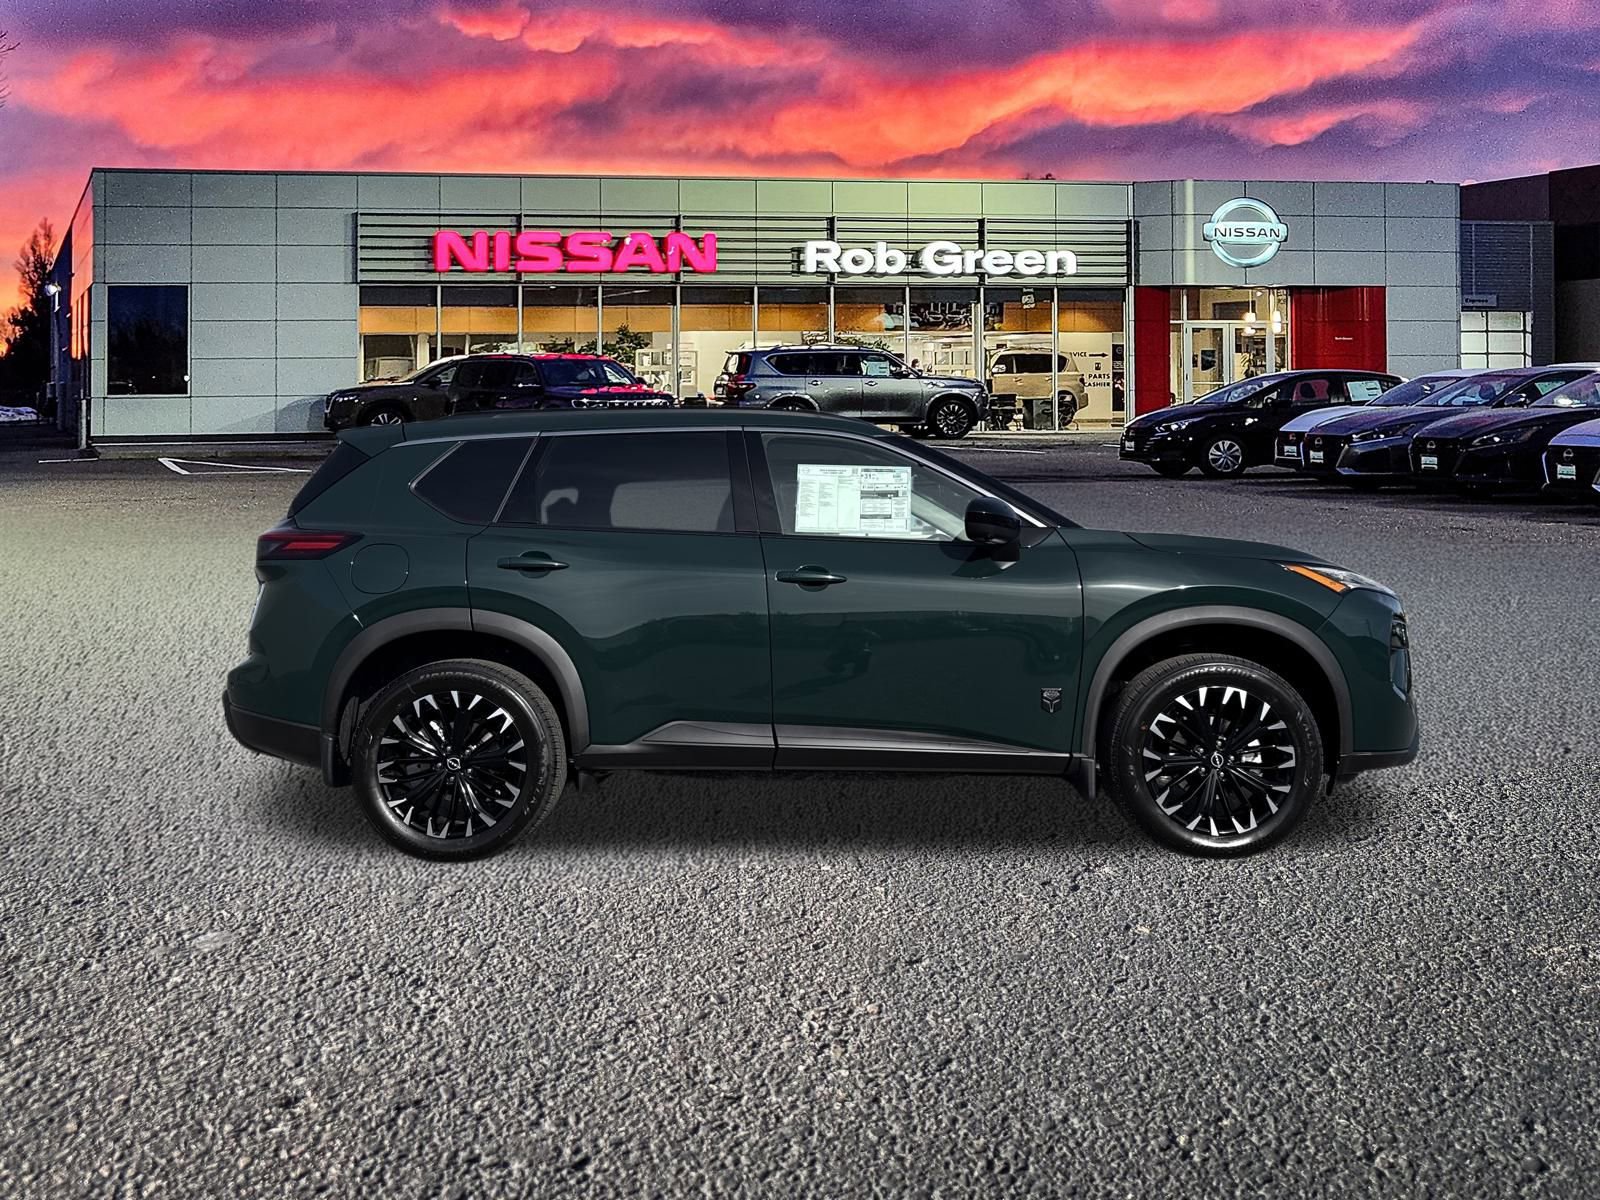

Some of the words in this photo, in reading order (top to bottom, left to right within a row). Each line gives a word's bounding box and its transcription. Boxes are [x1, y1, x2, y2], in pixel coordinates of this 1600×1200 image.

[1214, 227, 1280, 238] NISSAN
[434, 231, 717, 273] NISSAN
[804, 240, 907, 275] Rob
[921, 240, 1078, 275] Green
